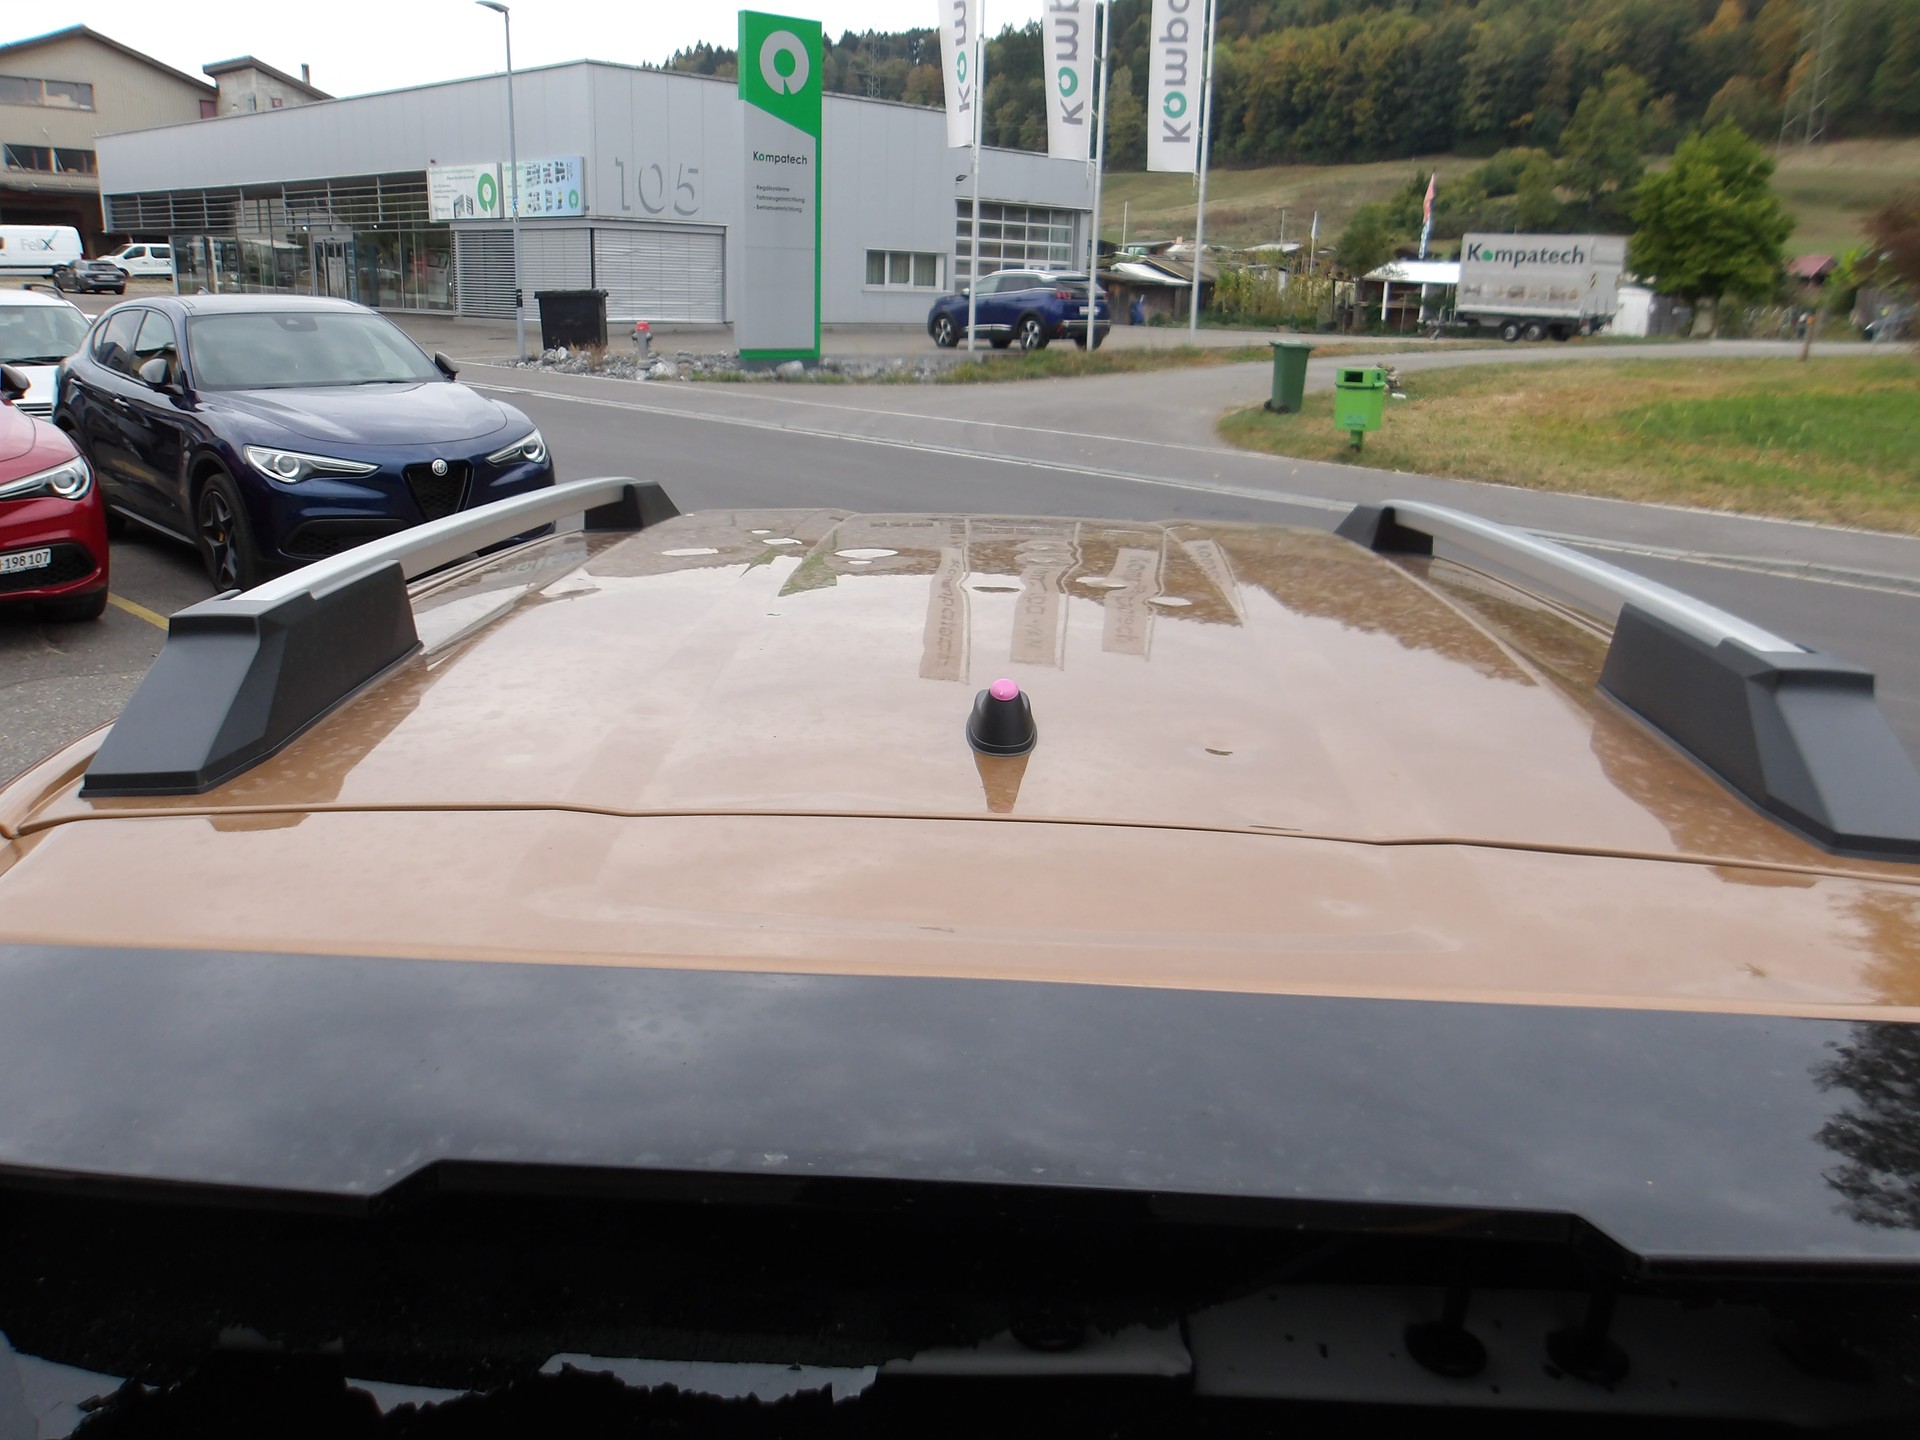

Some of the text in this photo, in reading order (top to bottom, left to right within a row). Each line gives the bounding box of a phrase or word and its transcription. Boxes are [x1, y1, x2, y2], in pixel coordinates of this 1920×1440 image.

[752, 151, 808, 165] Kompatech
[615, 157, 700, 216] 105
[1466, 243, 1584, 268] Kompatech
[5, 551, 49, 568] 198 107
